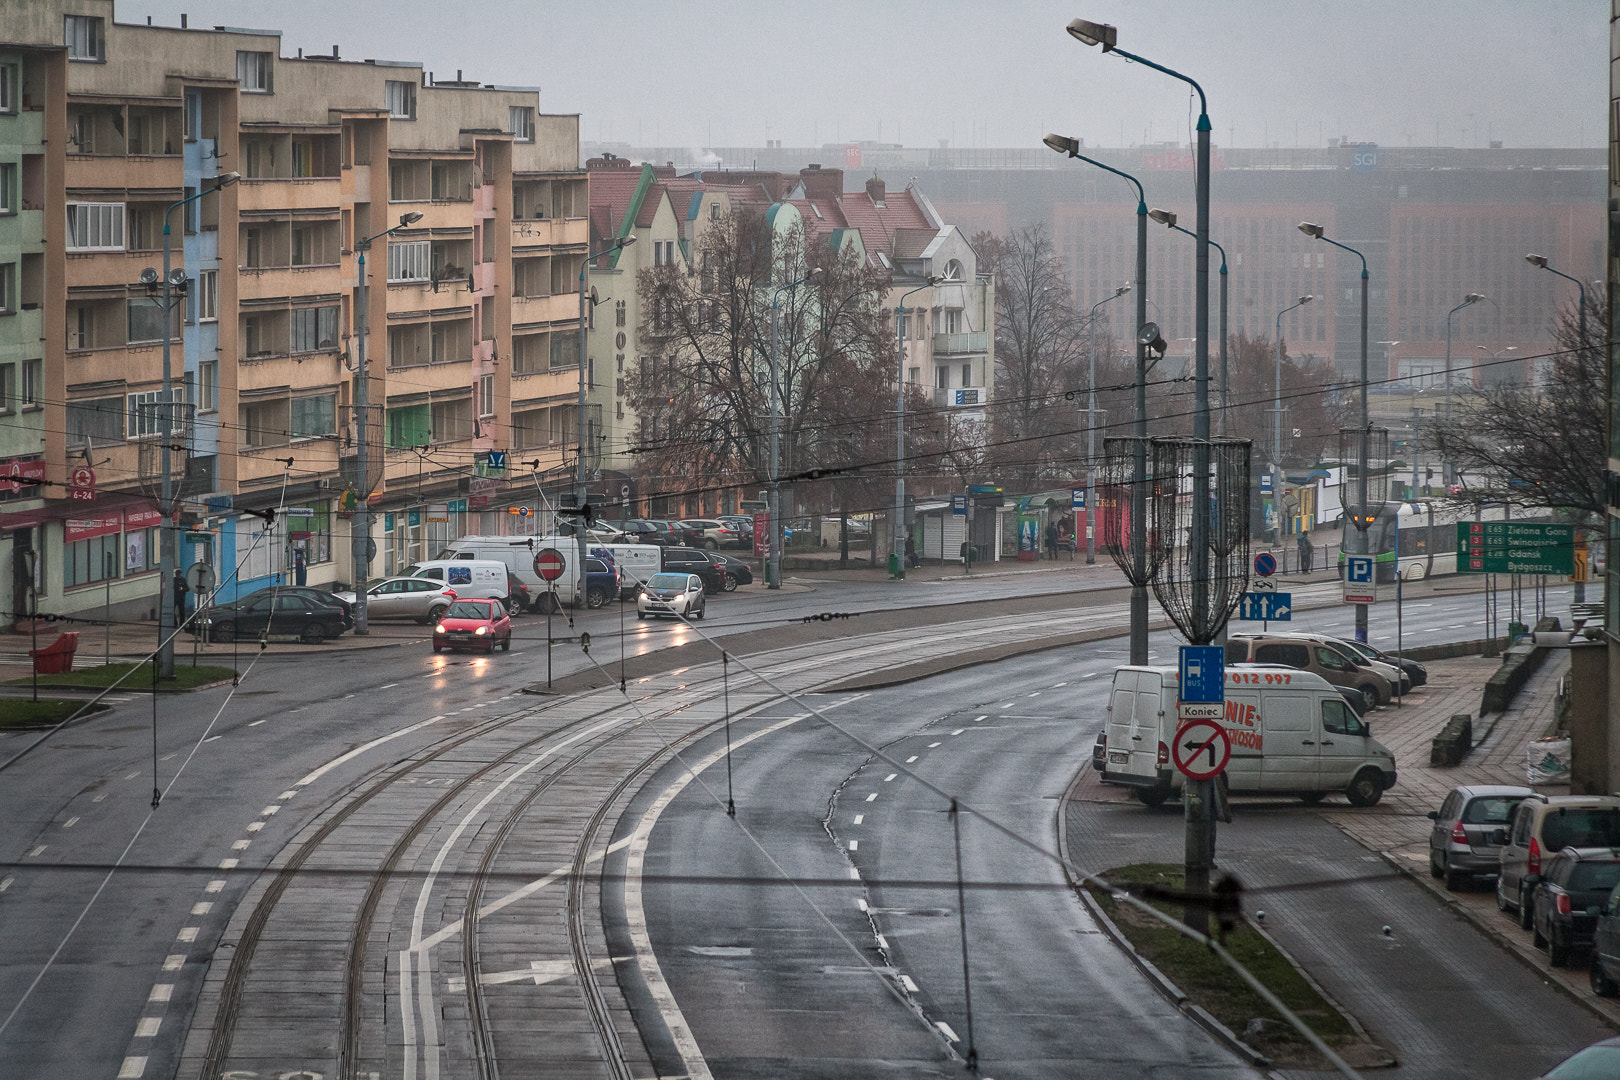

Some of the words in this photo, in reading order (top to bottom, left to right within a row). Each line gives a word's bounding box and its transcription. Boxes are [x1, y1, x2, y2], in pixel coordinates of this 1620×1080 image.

[846, 148, 860, 156] SEC
[1144, 150, 1224, 170] mBak
[1353, 153, 1377, 166] SGI
[73, 490, 92, 499] 6-24
[1507, 525, 1540, 535] Zielona
[1507, 561, 1552, 572] Bydgoszcz
[1232, 672, 1259, 684] 012
[1264, 673, 1291, 685] 997
[1184, 706, 1218, 716] Koniec
